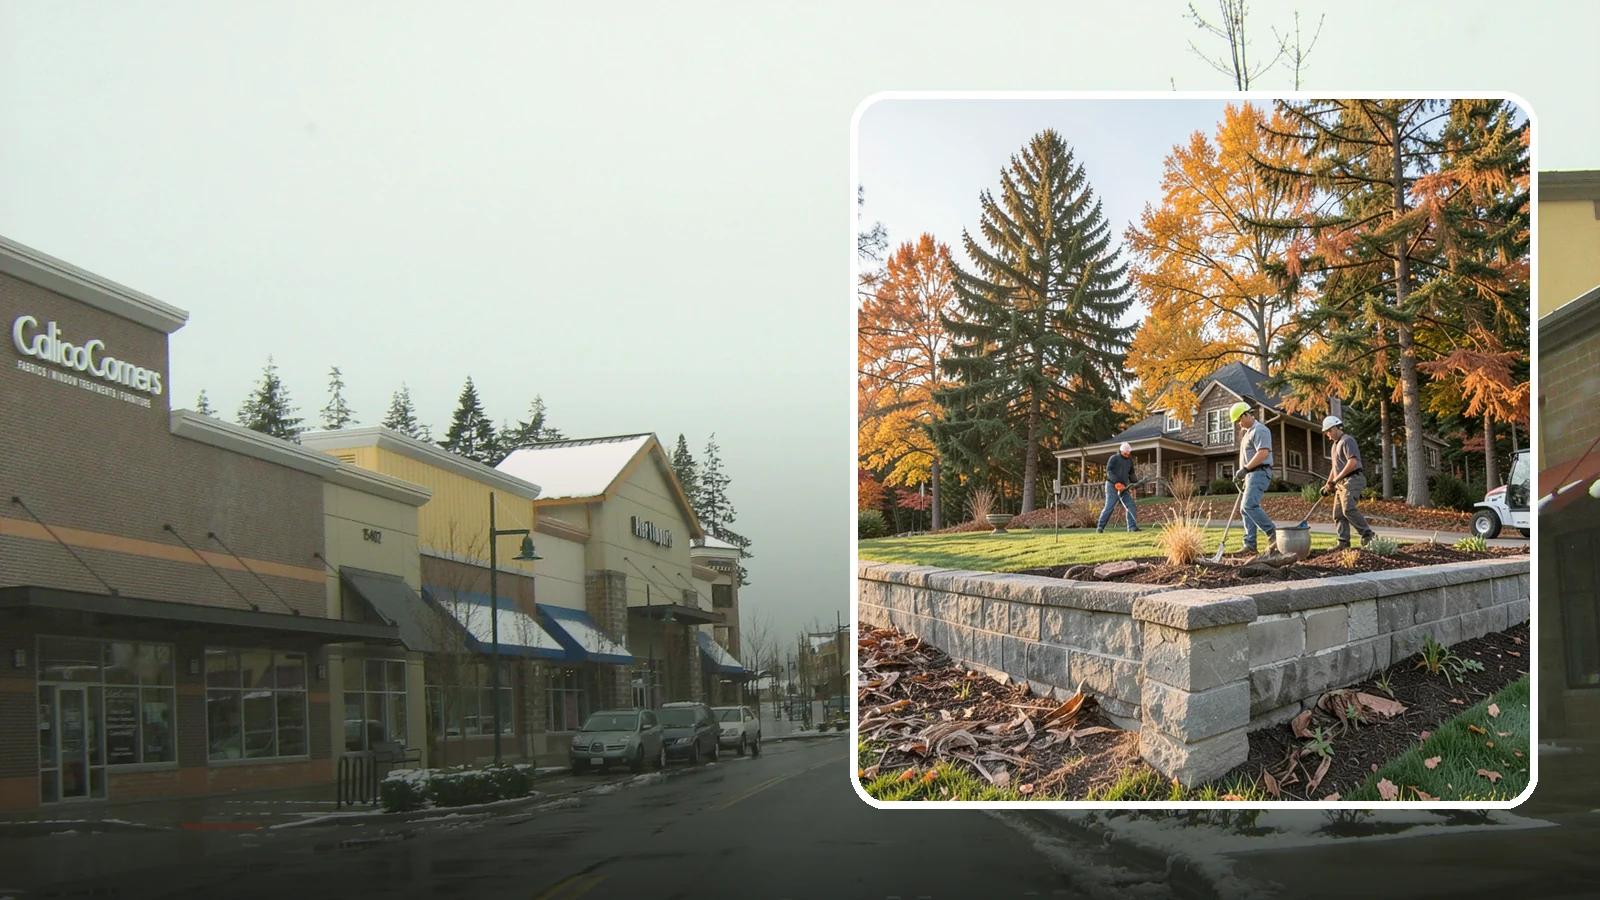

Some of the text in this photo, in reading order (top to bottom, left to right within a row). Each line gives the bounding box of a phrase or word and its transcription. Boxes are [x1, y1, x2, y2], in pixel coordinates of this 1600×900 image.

[17, 360, 47, 378] FABRICS
[51, 370, 78, 386] WINDOW
[78, 378, 116, 398] TREATMENTS
[120, 391, 151, 409] FURNITURE
